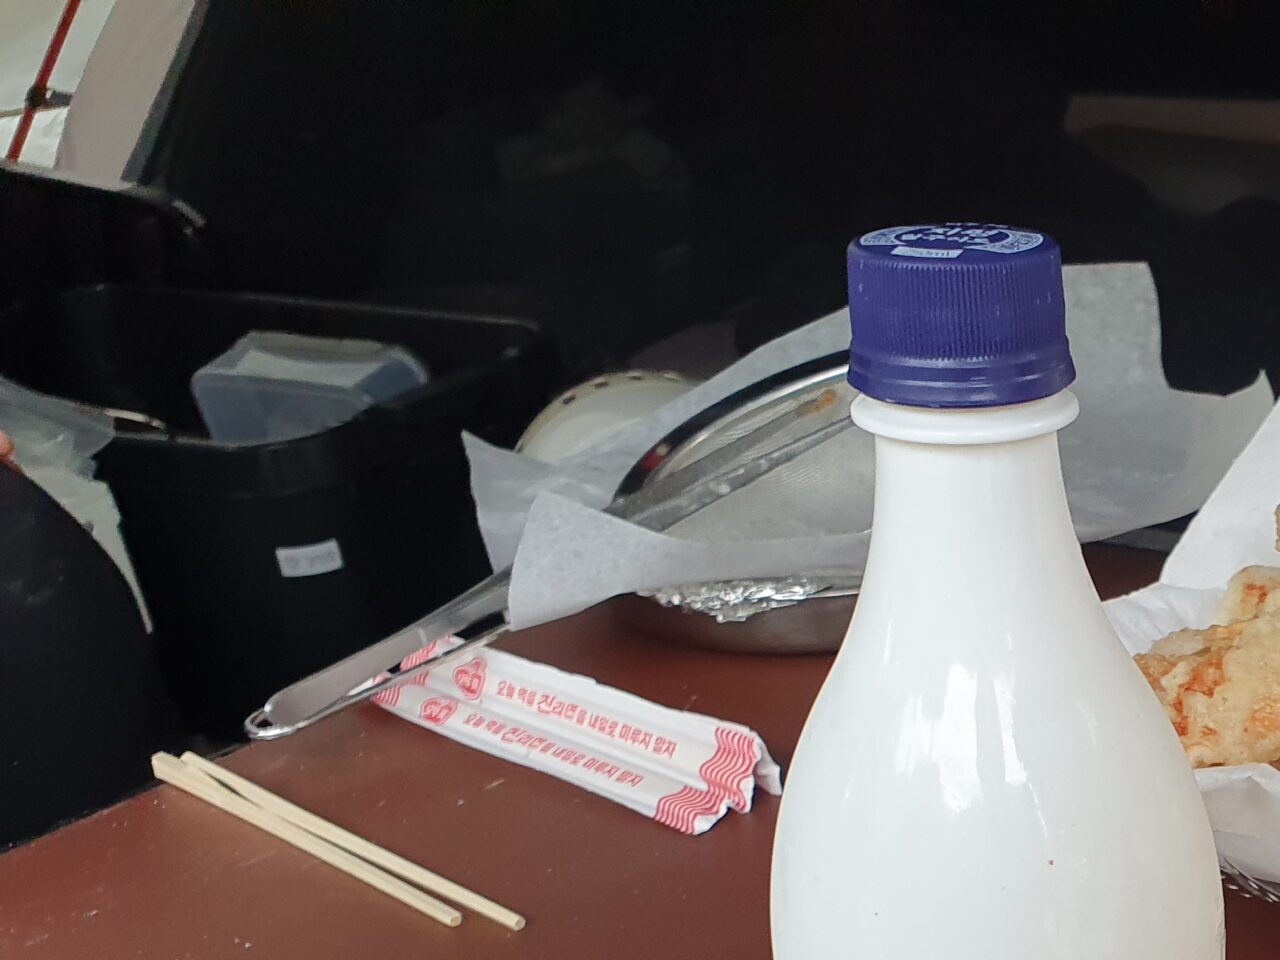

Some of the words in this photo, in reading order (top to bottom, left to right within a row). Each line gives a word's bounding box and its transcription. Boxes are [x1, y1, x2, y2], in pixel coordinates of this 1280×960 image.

[496, 680, 516, 699] 오늘
[589, 714, 619, 738] 내일로
[619, 723, 653, 749] 미루지
[653, 736, 678, 758] 말자
